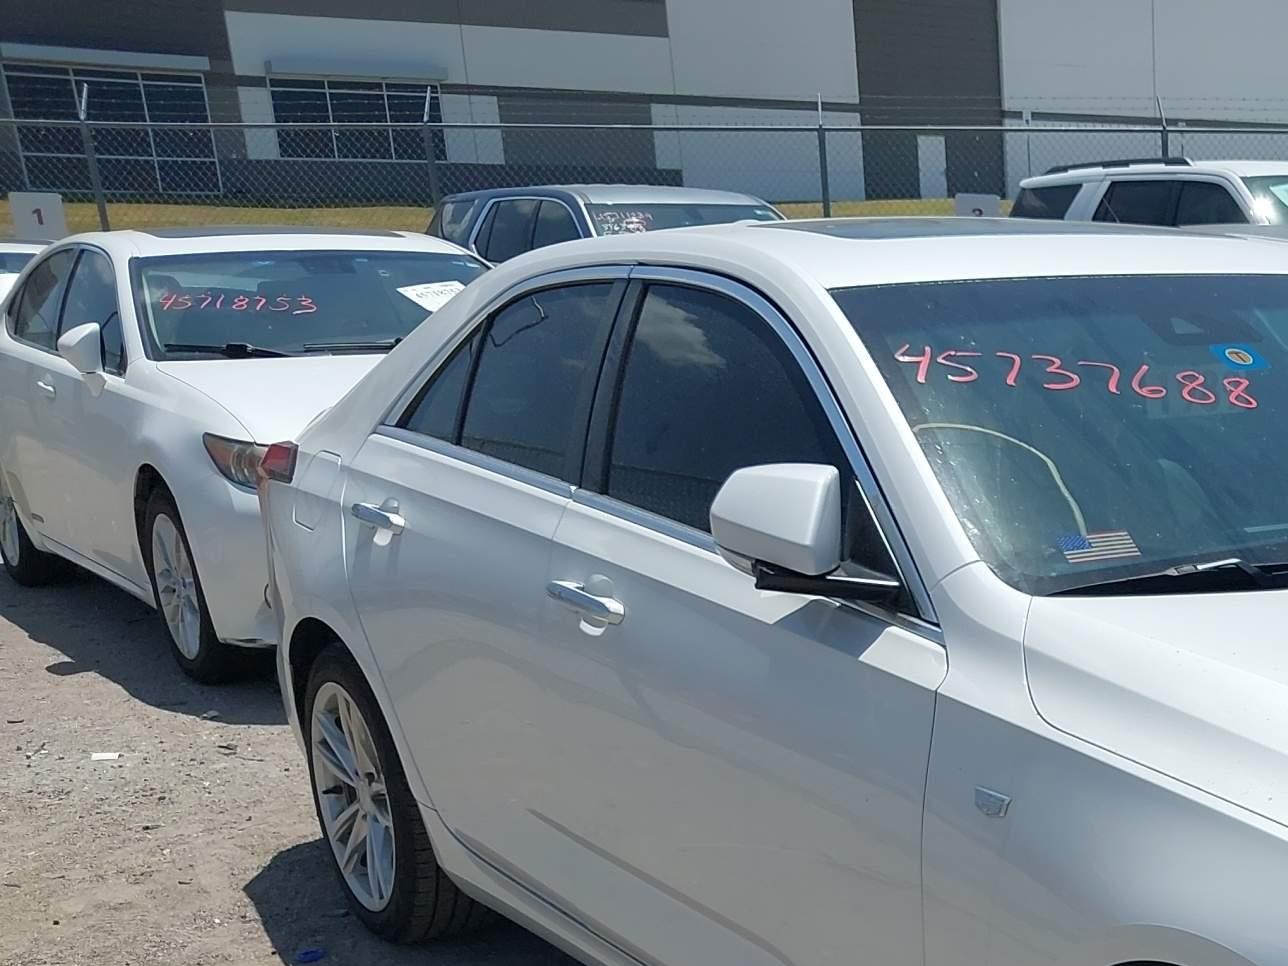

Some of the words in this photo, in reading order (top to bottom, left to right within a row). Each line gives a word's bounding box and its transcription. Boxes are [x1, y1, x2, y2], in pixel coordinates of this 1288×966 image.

[32, 208, 44, 225] 1
[159, 293, 318, 315] 45718753
[894, 343, 1258, 408] 45737688
